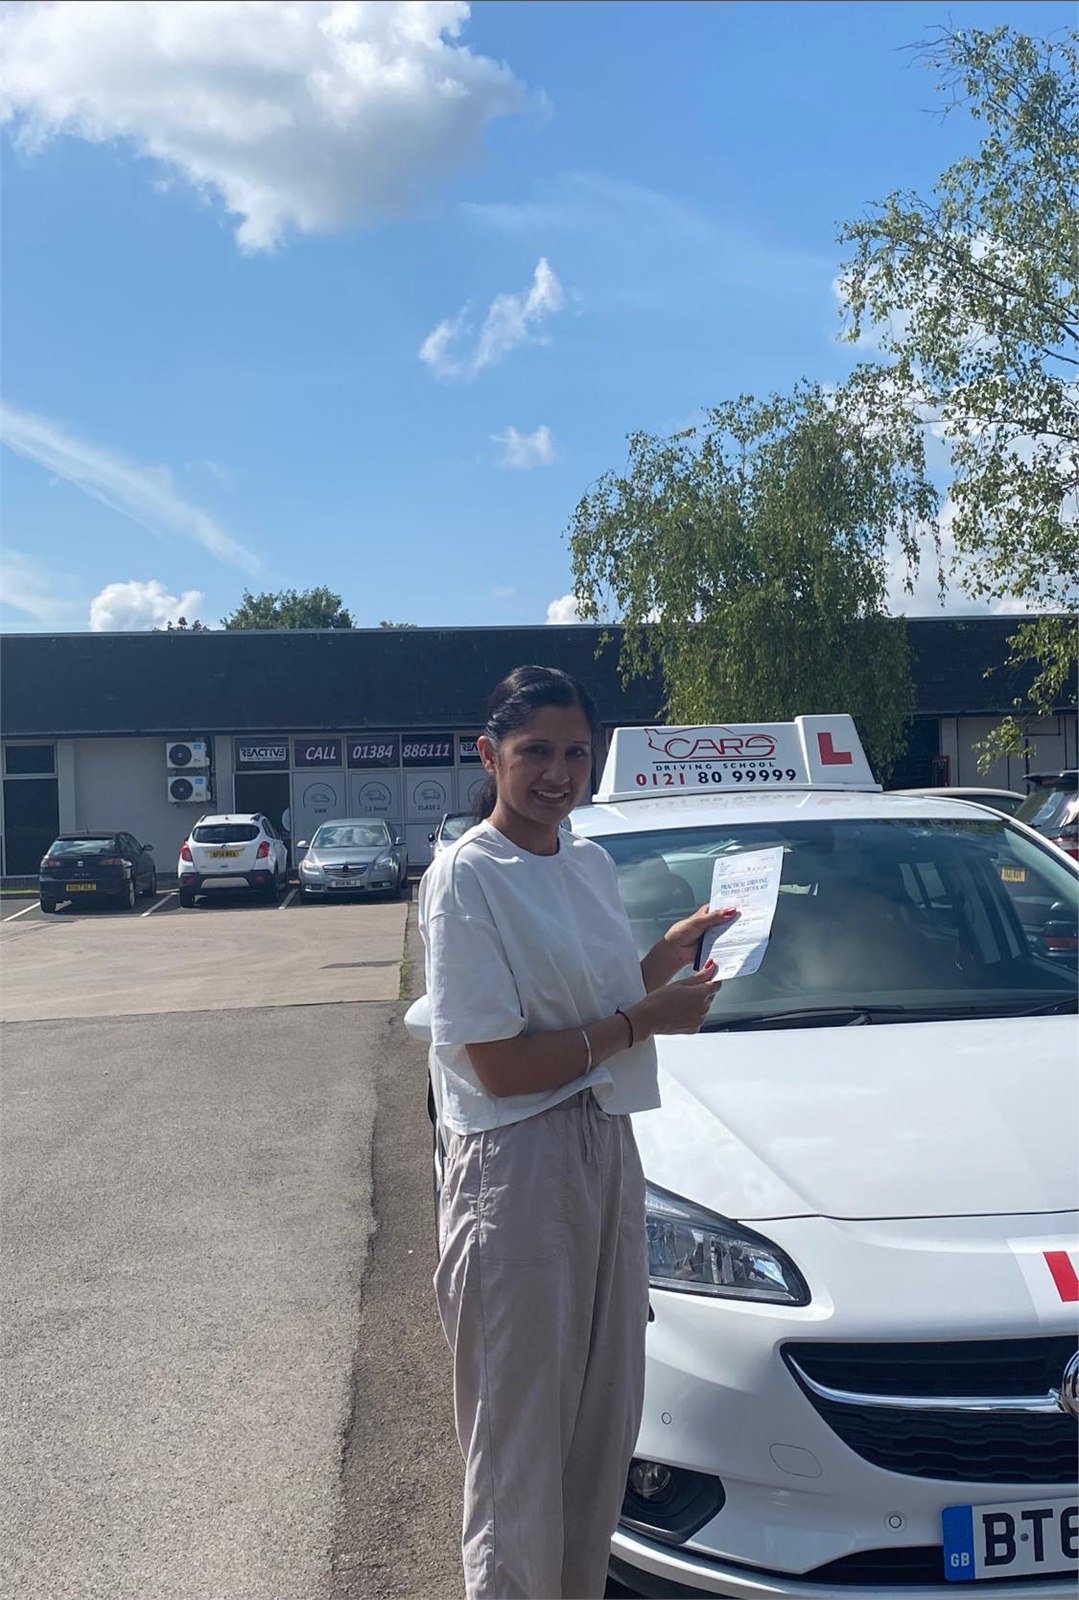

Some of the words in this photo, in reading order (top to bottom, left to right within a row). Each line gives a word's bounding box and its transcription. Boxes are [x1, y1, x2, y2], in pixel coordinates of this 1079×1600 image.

[241, 748, 285, 757] REACTIVE
[305, 746, 336, 760] CALL
[352, 744, 393, 759] 01384
[402, 743, 450, 757] 886111
[664, 734, 777, 760] CARS
[817, 732, 853, 765] L
[655, 763, 713, 771] DRIVING
[722, 761, 775, 770] SCHOOL
[635, 773, 686, 786] 0121
[698, 771, 722, 784] 80
[732, 768, 797, 782] 99999
[721, 881, 746, 890] PRACTICAL
[950, 1552, 971, 1567] GB
